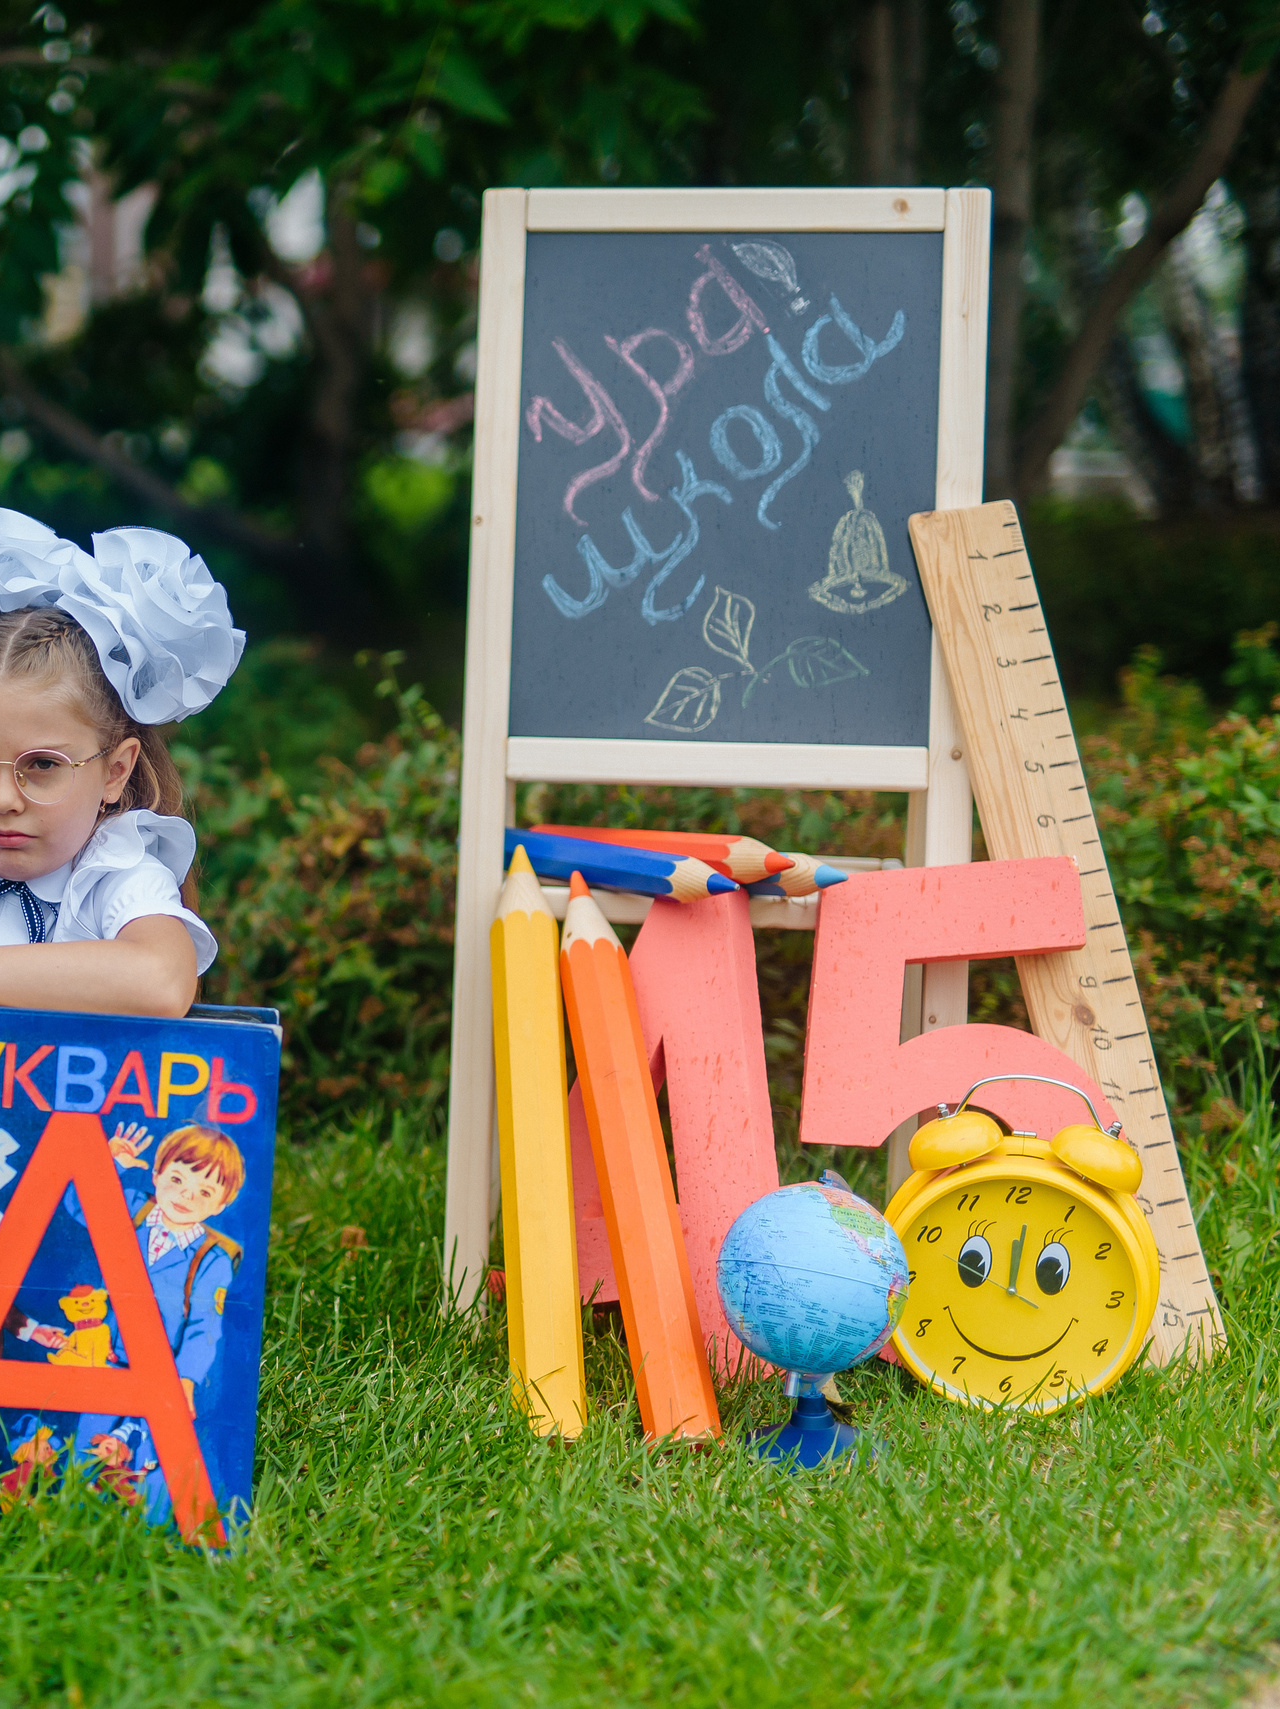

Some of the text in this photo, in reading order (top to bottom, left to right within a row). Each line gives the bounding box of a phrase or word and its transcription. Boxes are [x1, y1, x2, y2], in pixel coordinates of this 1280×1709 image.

[981, 603, 1002, 622] 2
[997, 657, 1018, 668] 3
[1010, 708, 1029, 721] 4
[1024, 760, 1045, 775] 5
[1090, 1023, 1113, 1051] 10
[956, 1193, 981, 1212] 11
[1004, 1185, 1033, 1205] 12
[1063, 1205, 1076, 1223] 1
[916, 1225, 943, 1244] 10
[1094, 1242, 1112, 1260] 2
[1105, 1290, 1125, 1309] 3
[915, 1318, 933, 1338] 8
[1091, 1338, 1109, 1357] 4
[951, 1356, 967, 1375] 7
[998, 1375, 1014, 1394] 6
[1048, 1369, 1067, 1388] 5
